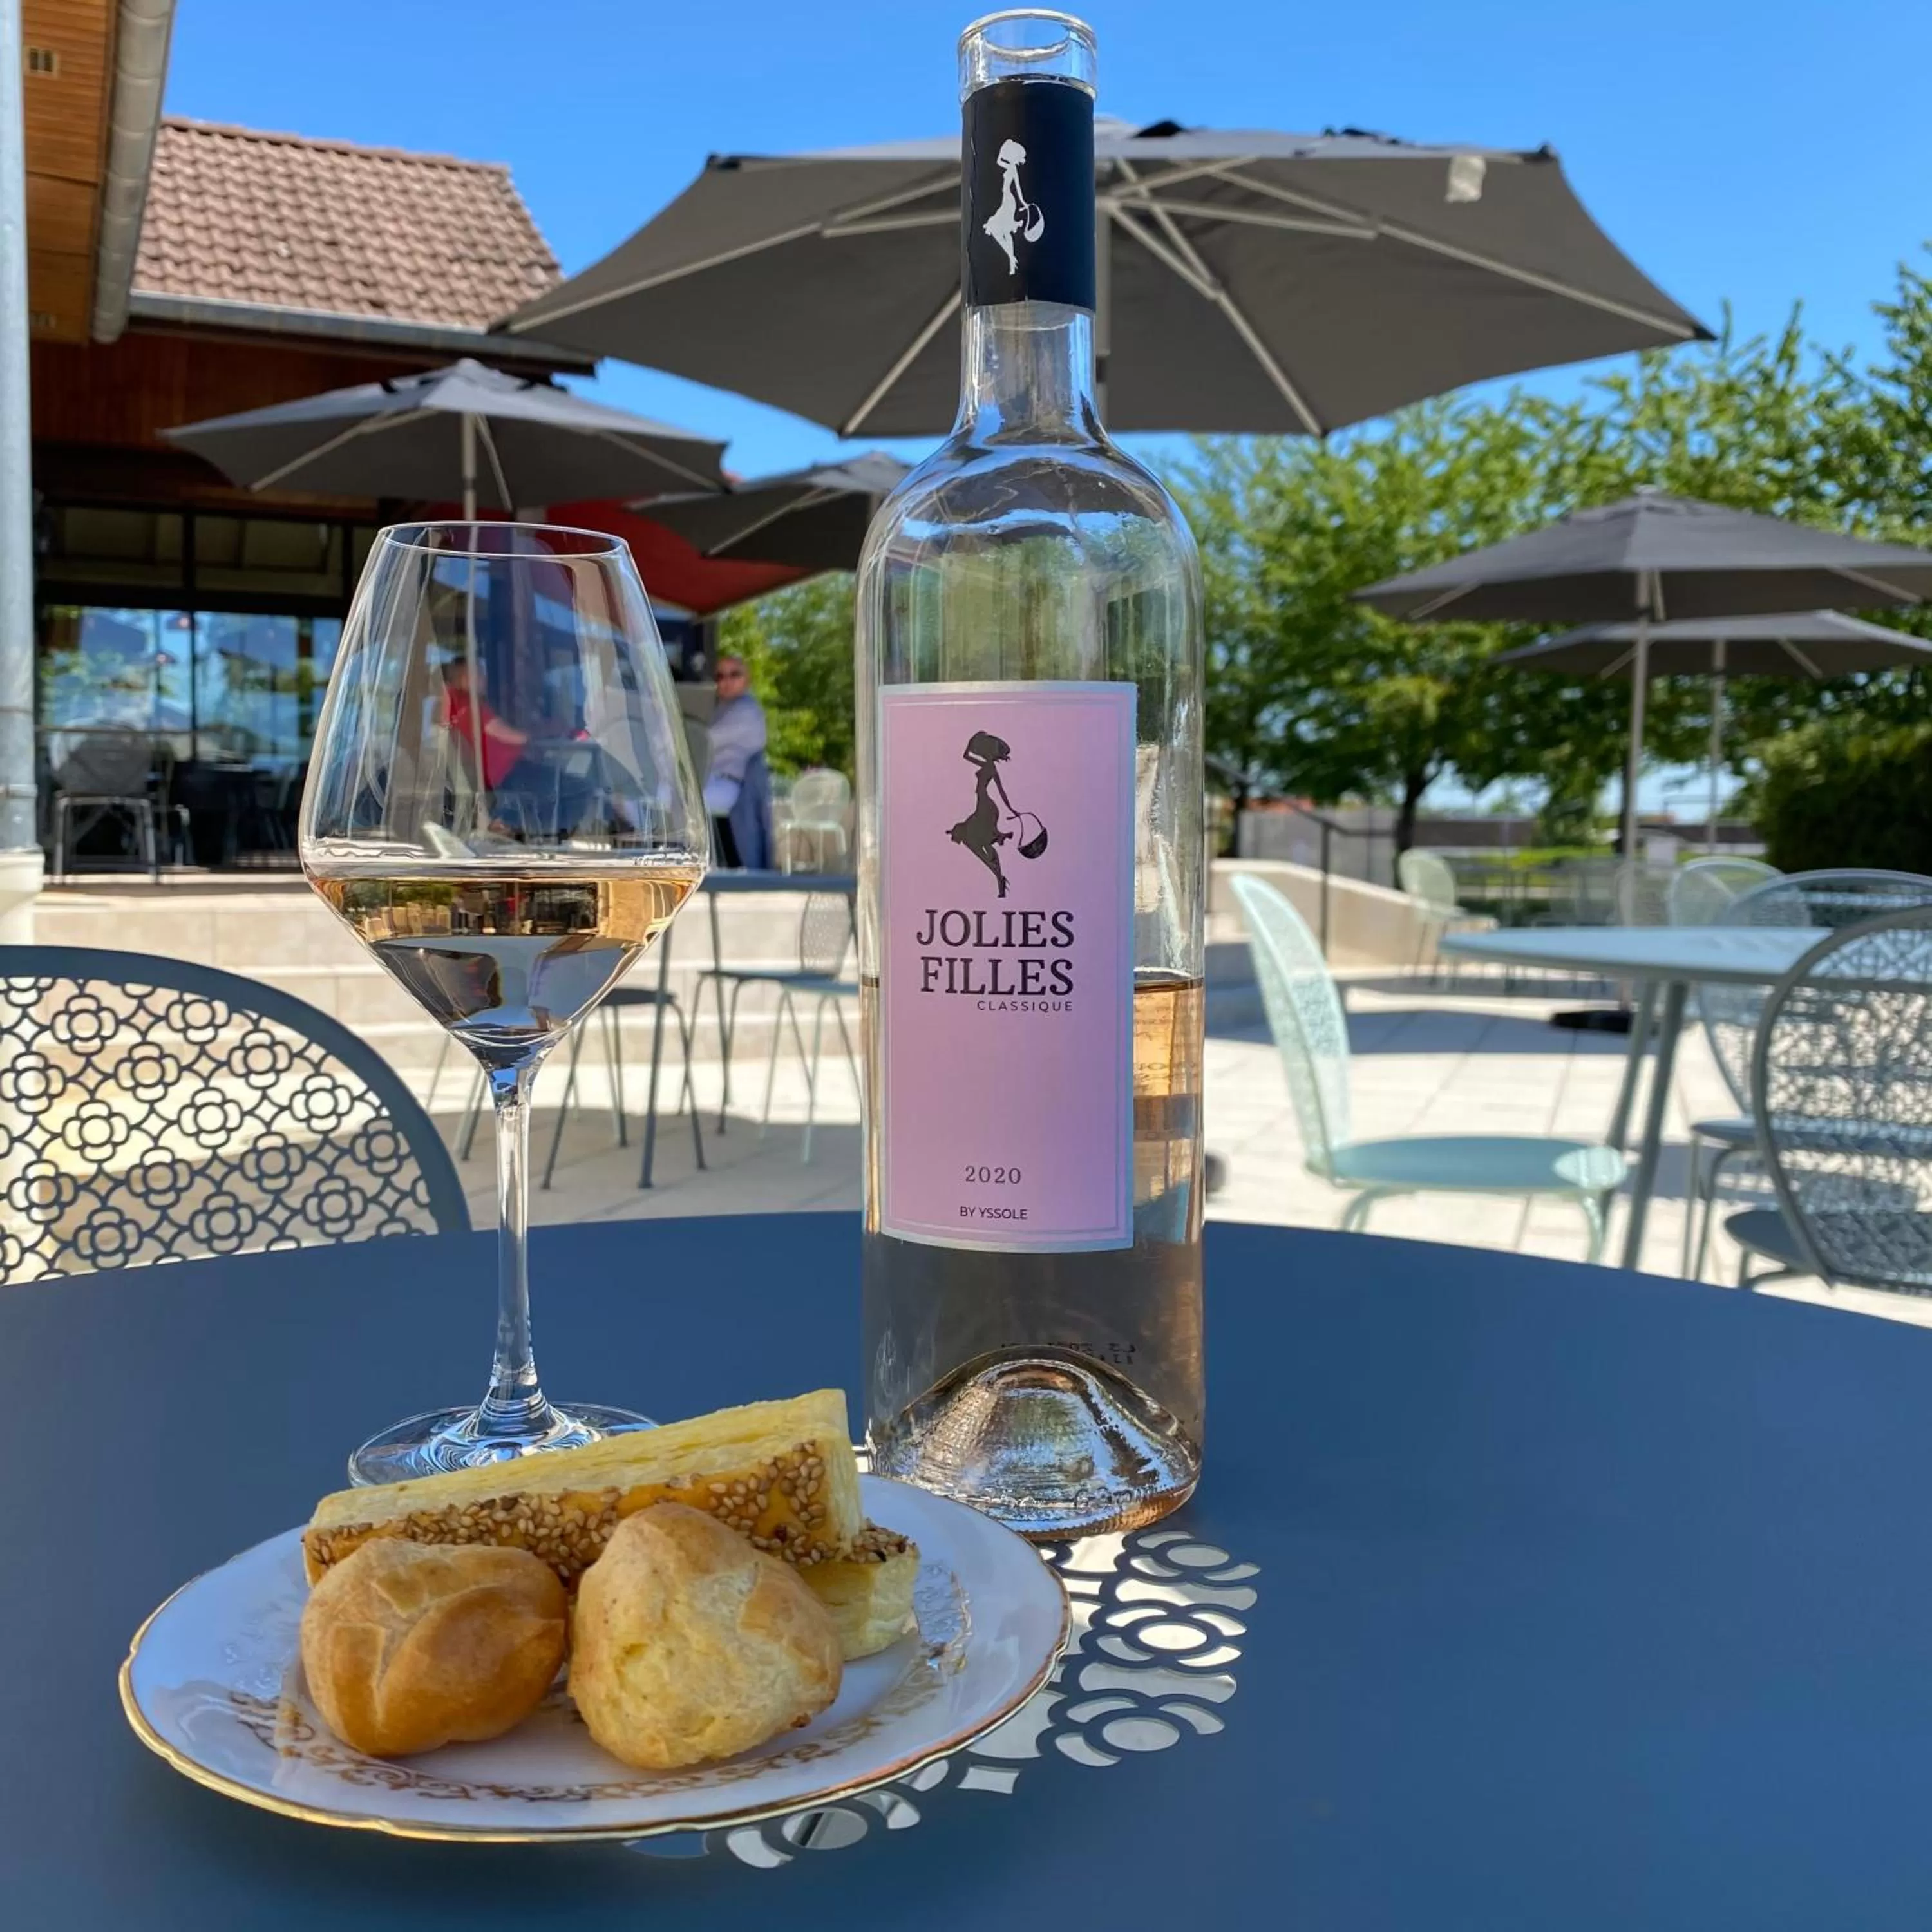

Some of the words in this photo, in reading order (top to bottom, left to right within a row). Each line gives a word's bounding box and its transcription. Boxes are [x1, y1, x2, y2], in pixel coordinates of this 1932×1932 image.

[916, 909, 1074, 948] JOLIES
[920, 956, 1074, 996] FILLES
[977, 1000, 1072, 1013] CLASSIQUE
[965, 1166, 1021, 1184] 2020
[960, 1206, 976, 1217] BY
[979, 1207, 1028, 1220] YSSOLE
